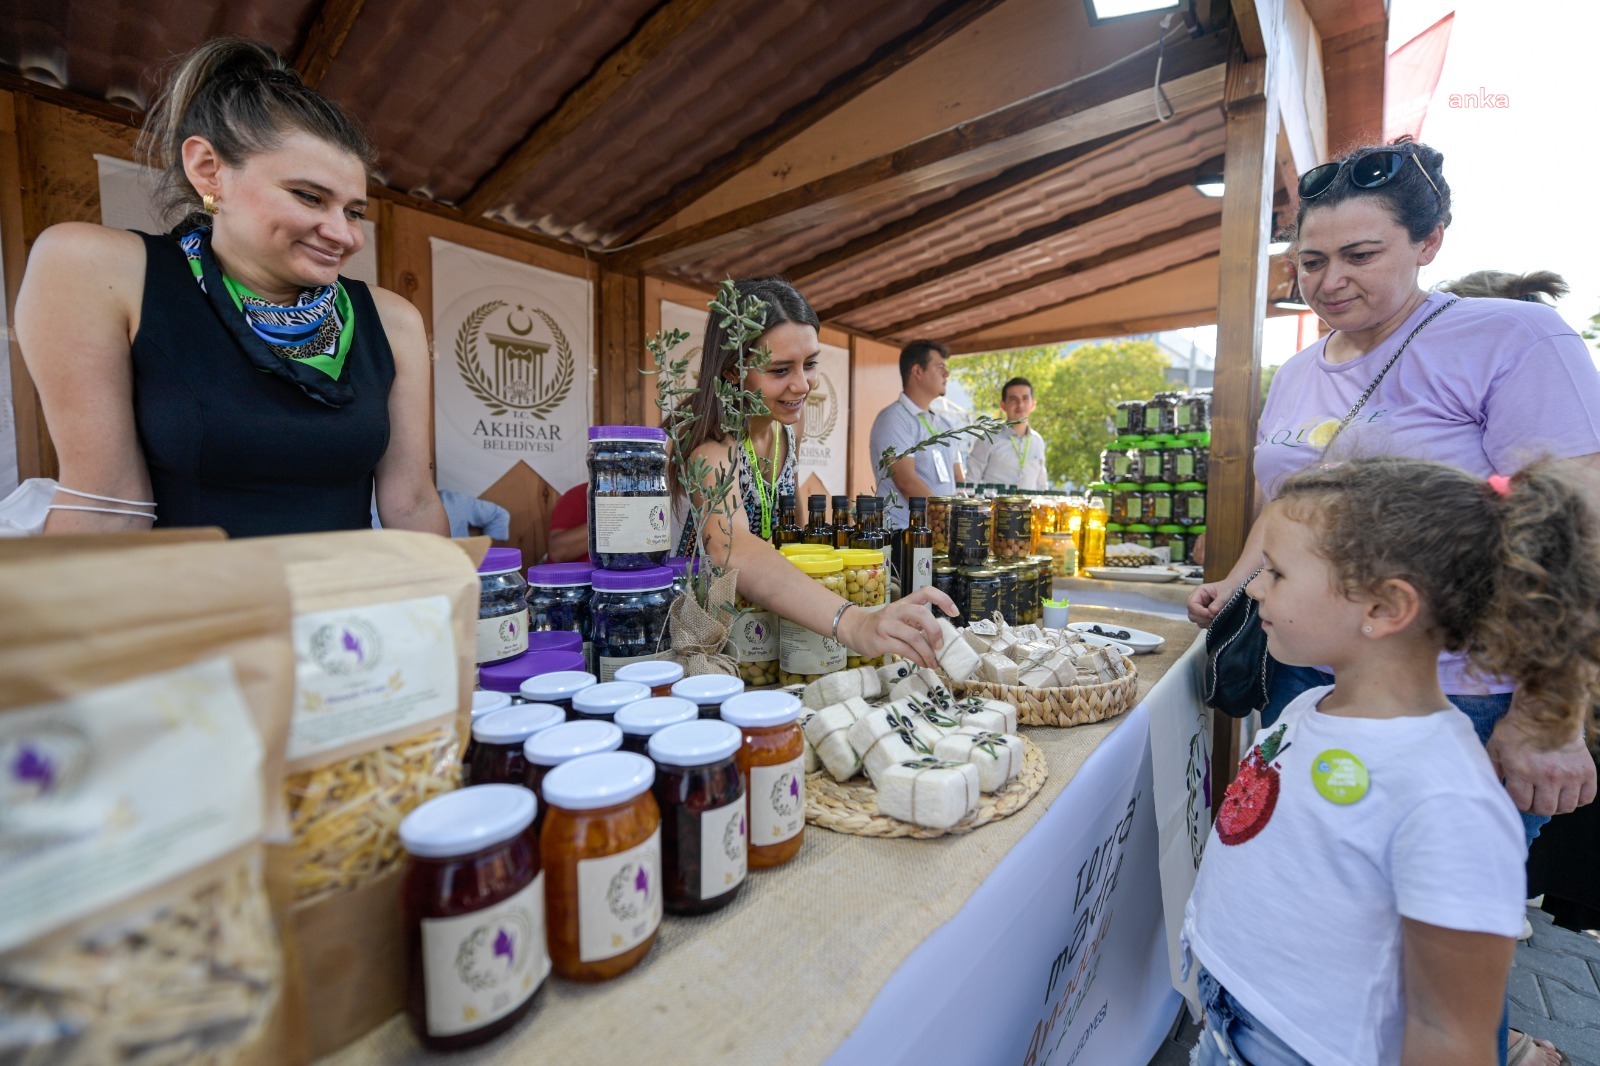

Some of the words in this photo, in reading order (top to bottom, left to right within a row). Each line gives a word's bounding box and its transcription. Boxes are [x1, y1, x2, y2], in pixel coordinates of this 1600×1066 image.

[512, 410, 530, 420] T.C.
[472, 419, 563, 441] AKHİSAR
[483, 439, 555, 453] BELEDİYESİ
[799, 446, 832, 459] KHİSAR
